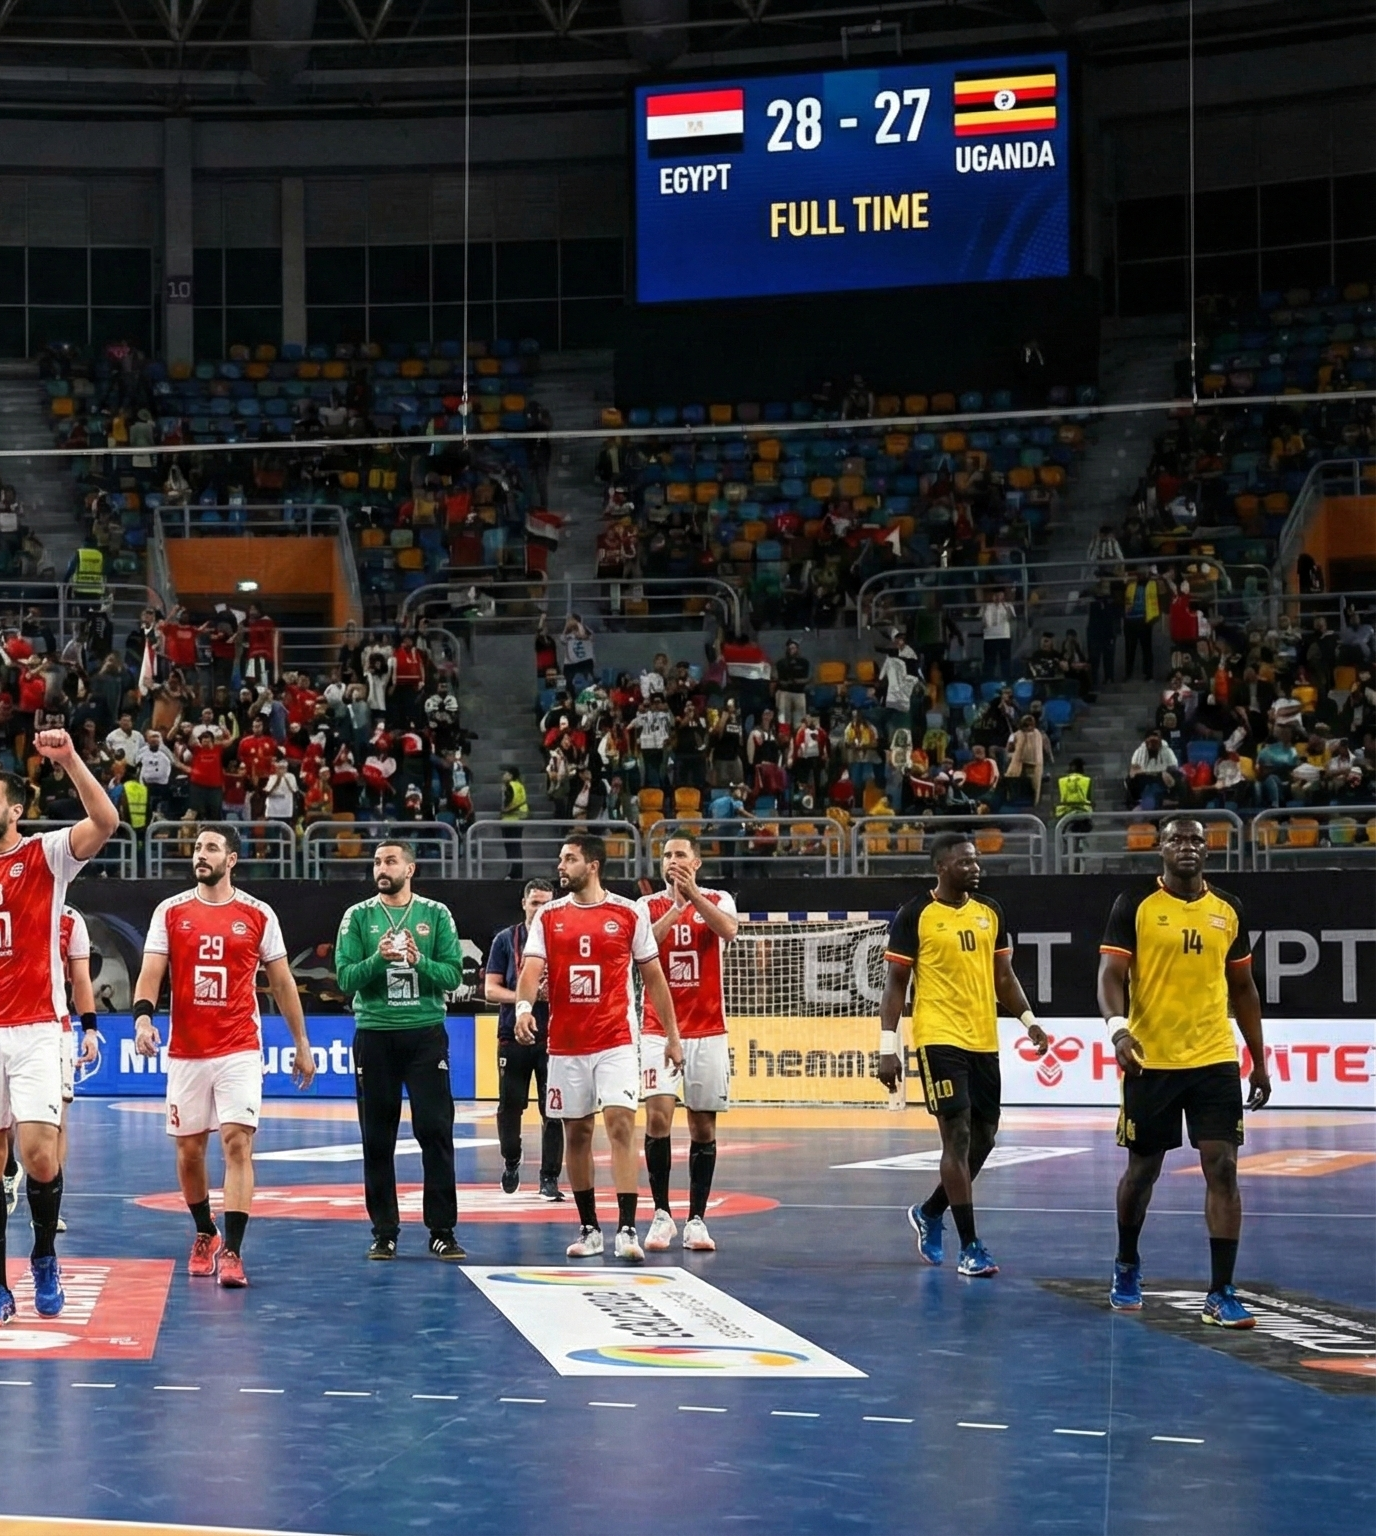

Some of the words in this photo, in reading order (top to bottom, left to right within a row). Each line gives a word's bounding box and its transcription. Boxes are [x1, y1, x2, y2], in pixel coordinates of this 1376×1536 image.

[766, 97, 822, 153] 28
[839, 117, 858, 129] -
[874, 88, 931, 145] 27
[955, 140, 1056, 174] UGANDA
[659, 163, 732, 195] EGYPT
[770, 199, 845, 239] FULL
[853, 192, 929, 233] TIME
[167, 281, 191, 298] 10
[198, 934, 224, 960] 29
[671, 924, 692, 946] 18
[957, 929, 977, 952] 10
[1181, 928, 1204, 955] 14
